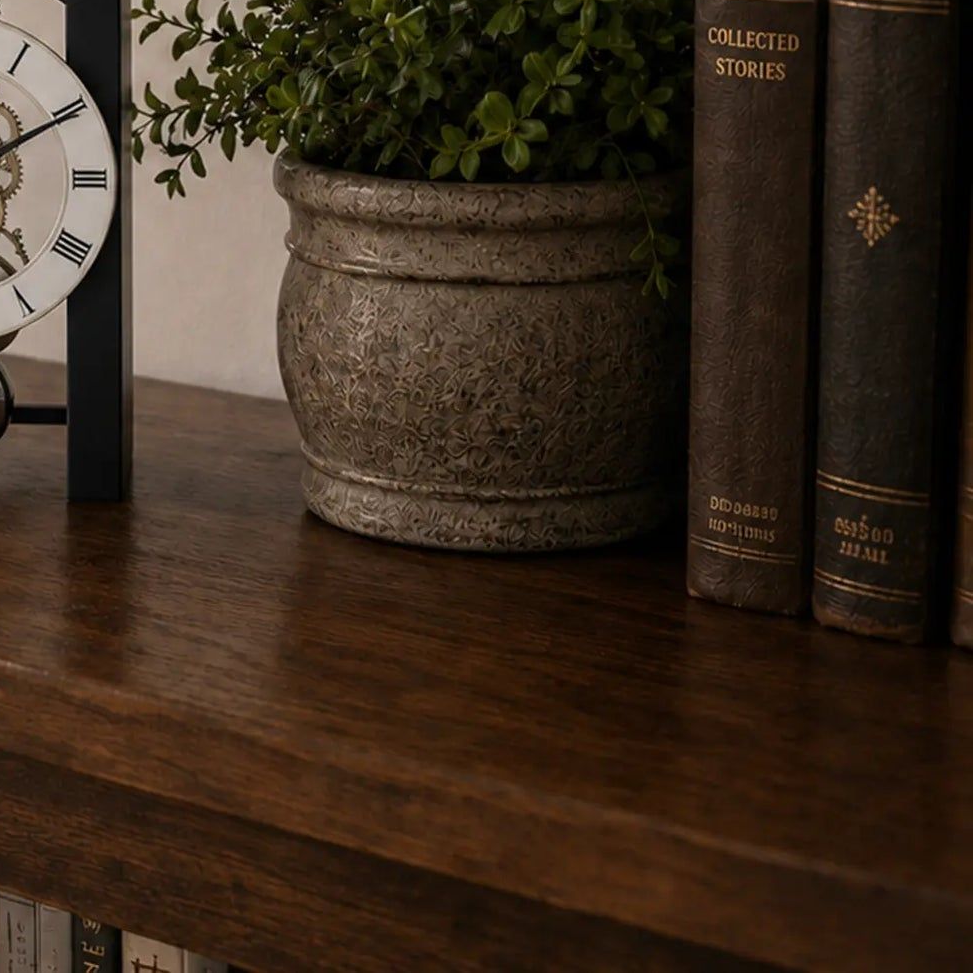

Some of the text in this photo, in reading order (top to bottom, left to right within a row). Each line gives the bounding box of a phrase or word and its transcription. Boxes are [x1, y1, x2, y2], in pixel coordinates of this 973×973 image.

[708, 26, 800, 53] COLLECTED
[7, 40, 31, 76] I
[715, 56, 787, 82] STORIES
[72, 168, 108, 191] III
[12, 284, 36, 318] V
